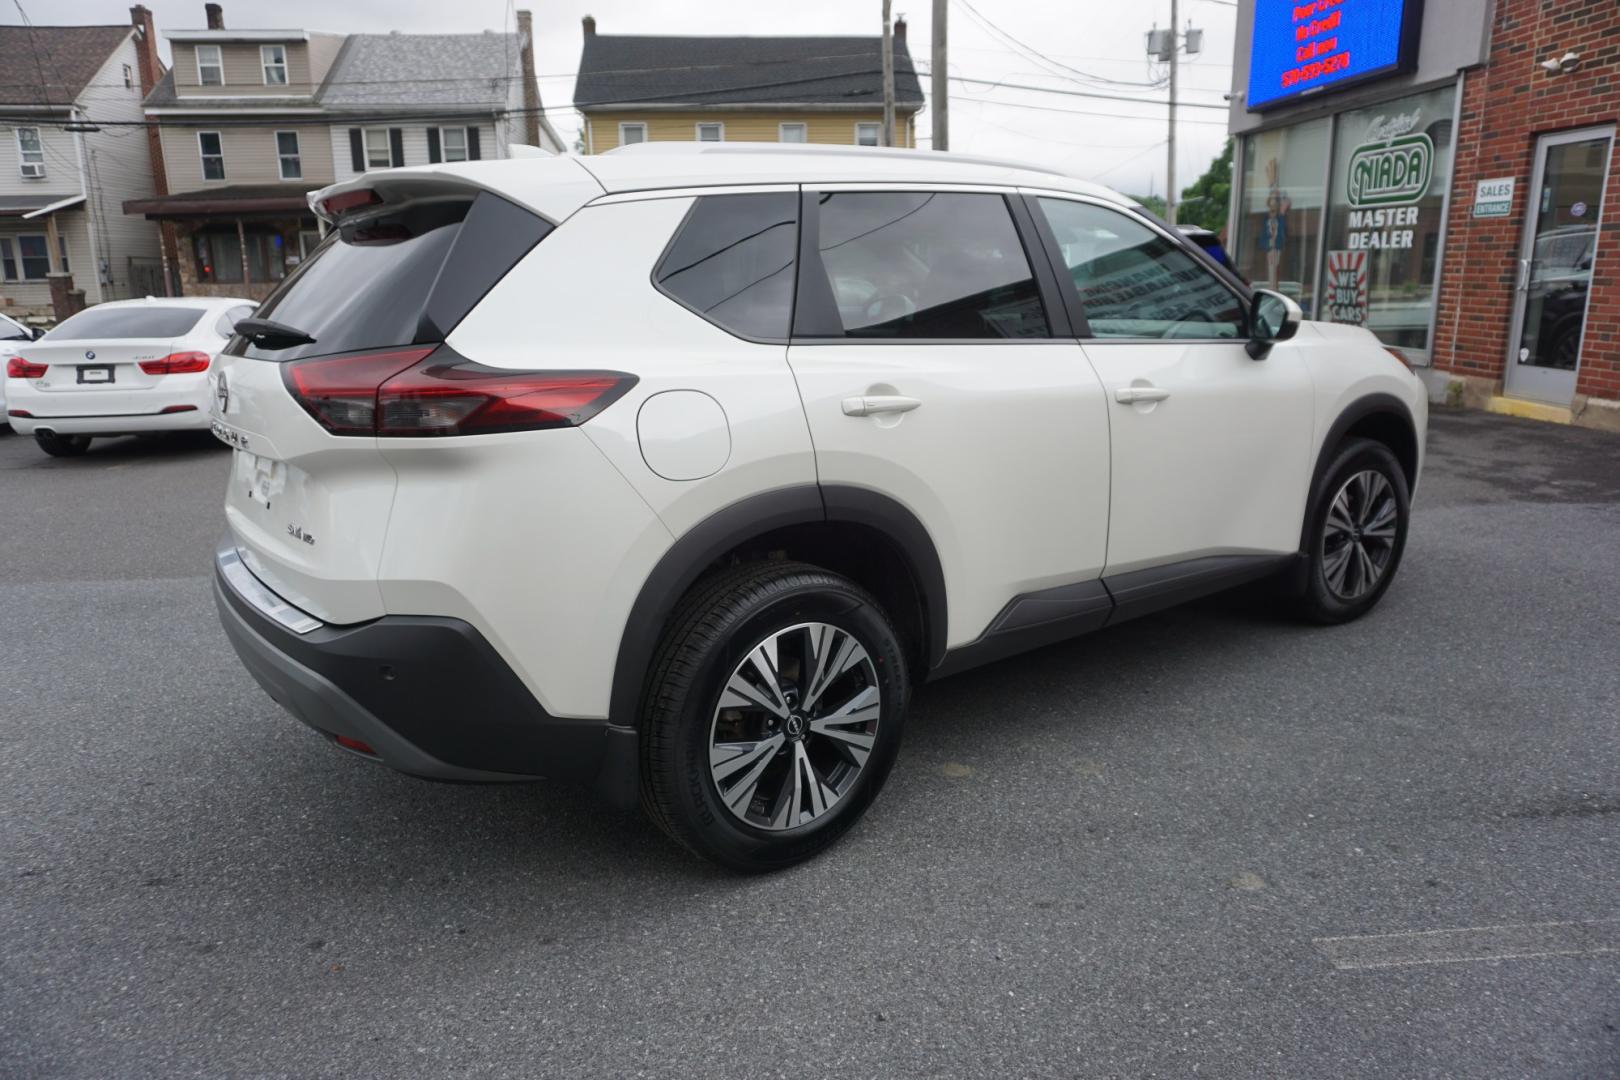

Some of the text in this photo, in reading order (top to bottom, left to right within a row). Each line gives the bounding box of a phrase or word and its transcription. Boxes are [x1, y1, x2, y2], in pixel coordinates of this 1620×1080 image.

[1354, 147, 1424, 194] NIADA
[1480, 184, 1511, 198] SALES
[1476, 202, 1510, 215] ENTRANCE
[1349, 207, 1419, 228] MASTER
[1348, 230, 1414, 249] DEALER
[1337, 271, 1358, 288] WE
[1336, 288, 1358, 304] BUY
[1331, 305, 1362, 321] CARS
